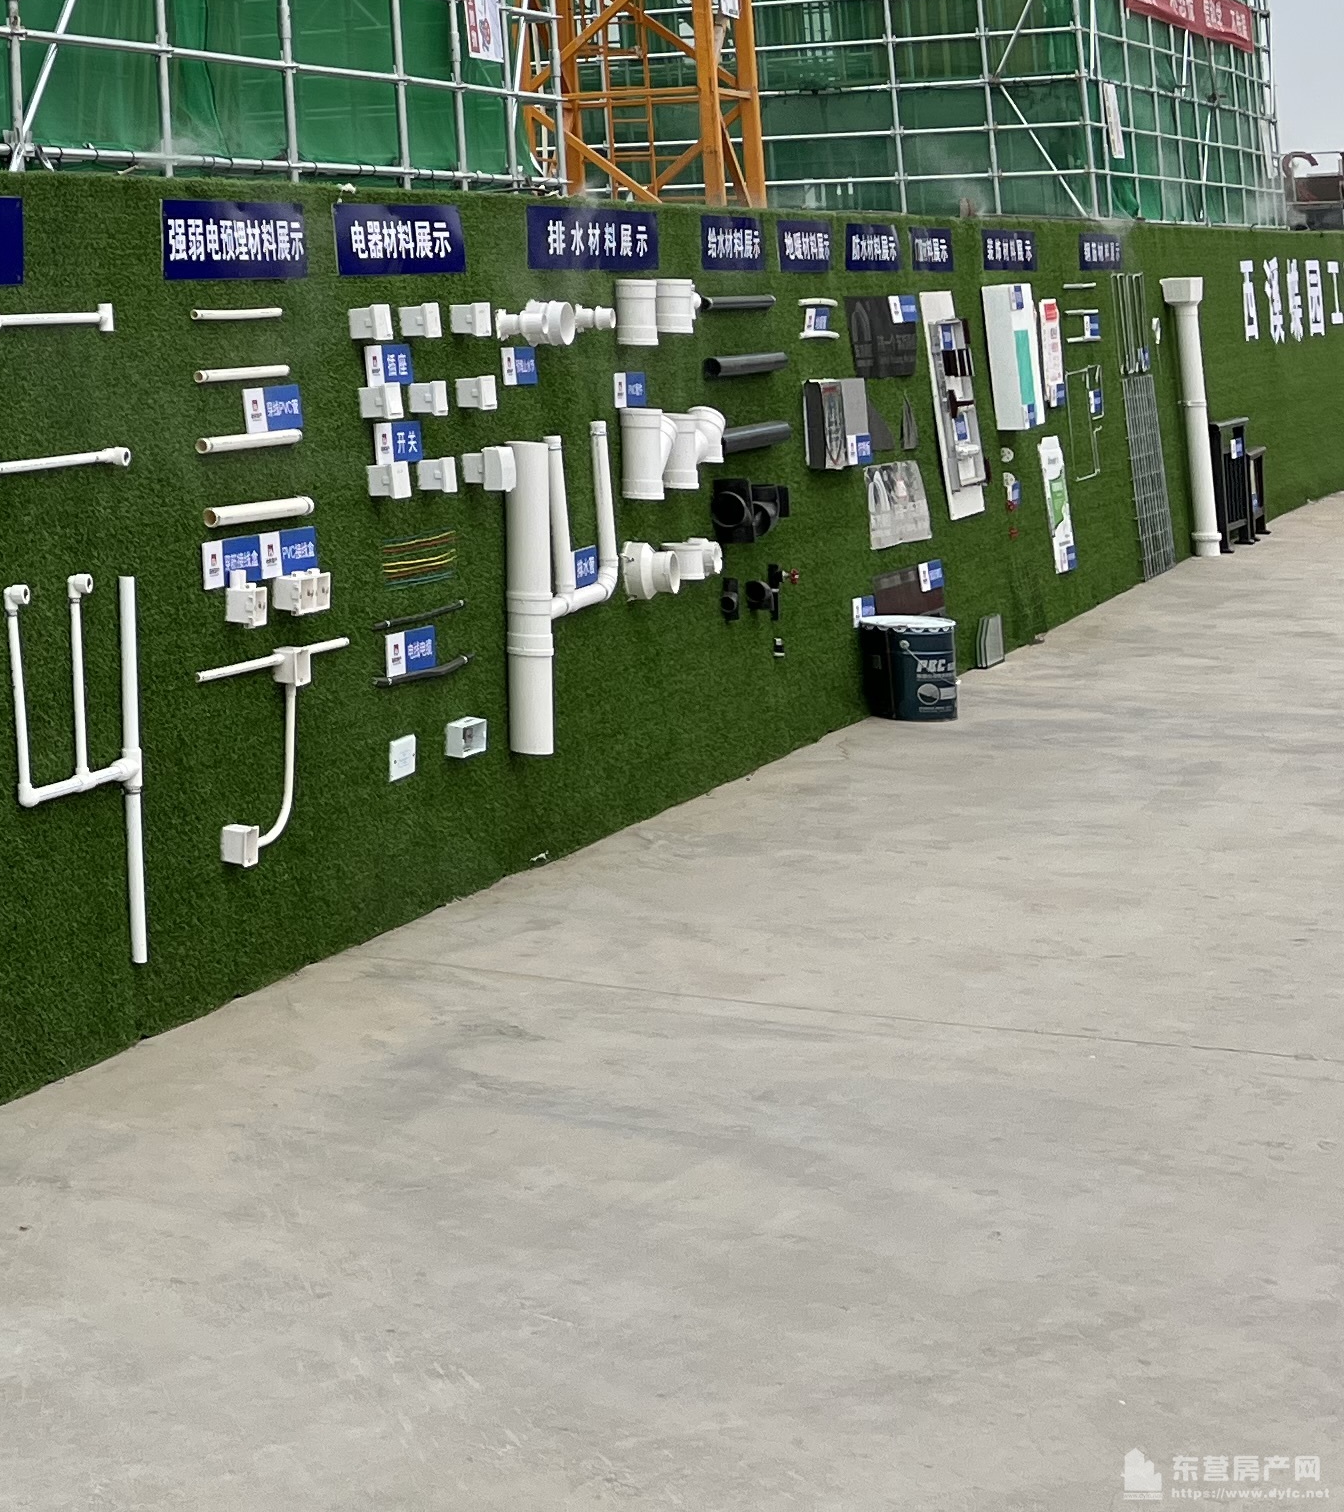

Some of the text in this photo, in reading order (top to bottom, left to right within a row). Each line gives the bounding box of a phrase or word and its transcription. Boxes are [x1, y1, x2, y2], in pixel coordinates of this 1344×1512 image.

[167, 218, 305, 262] 强弱电预埋材料展示
[350, 220, 452, 259] 电器材料展示
[547, 219, 649, 257] 排水材料展示
[396, 431, 420, 454] 开关
[407, 638, 433, 661] 电线电缆
